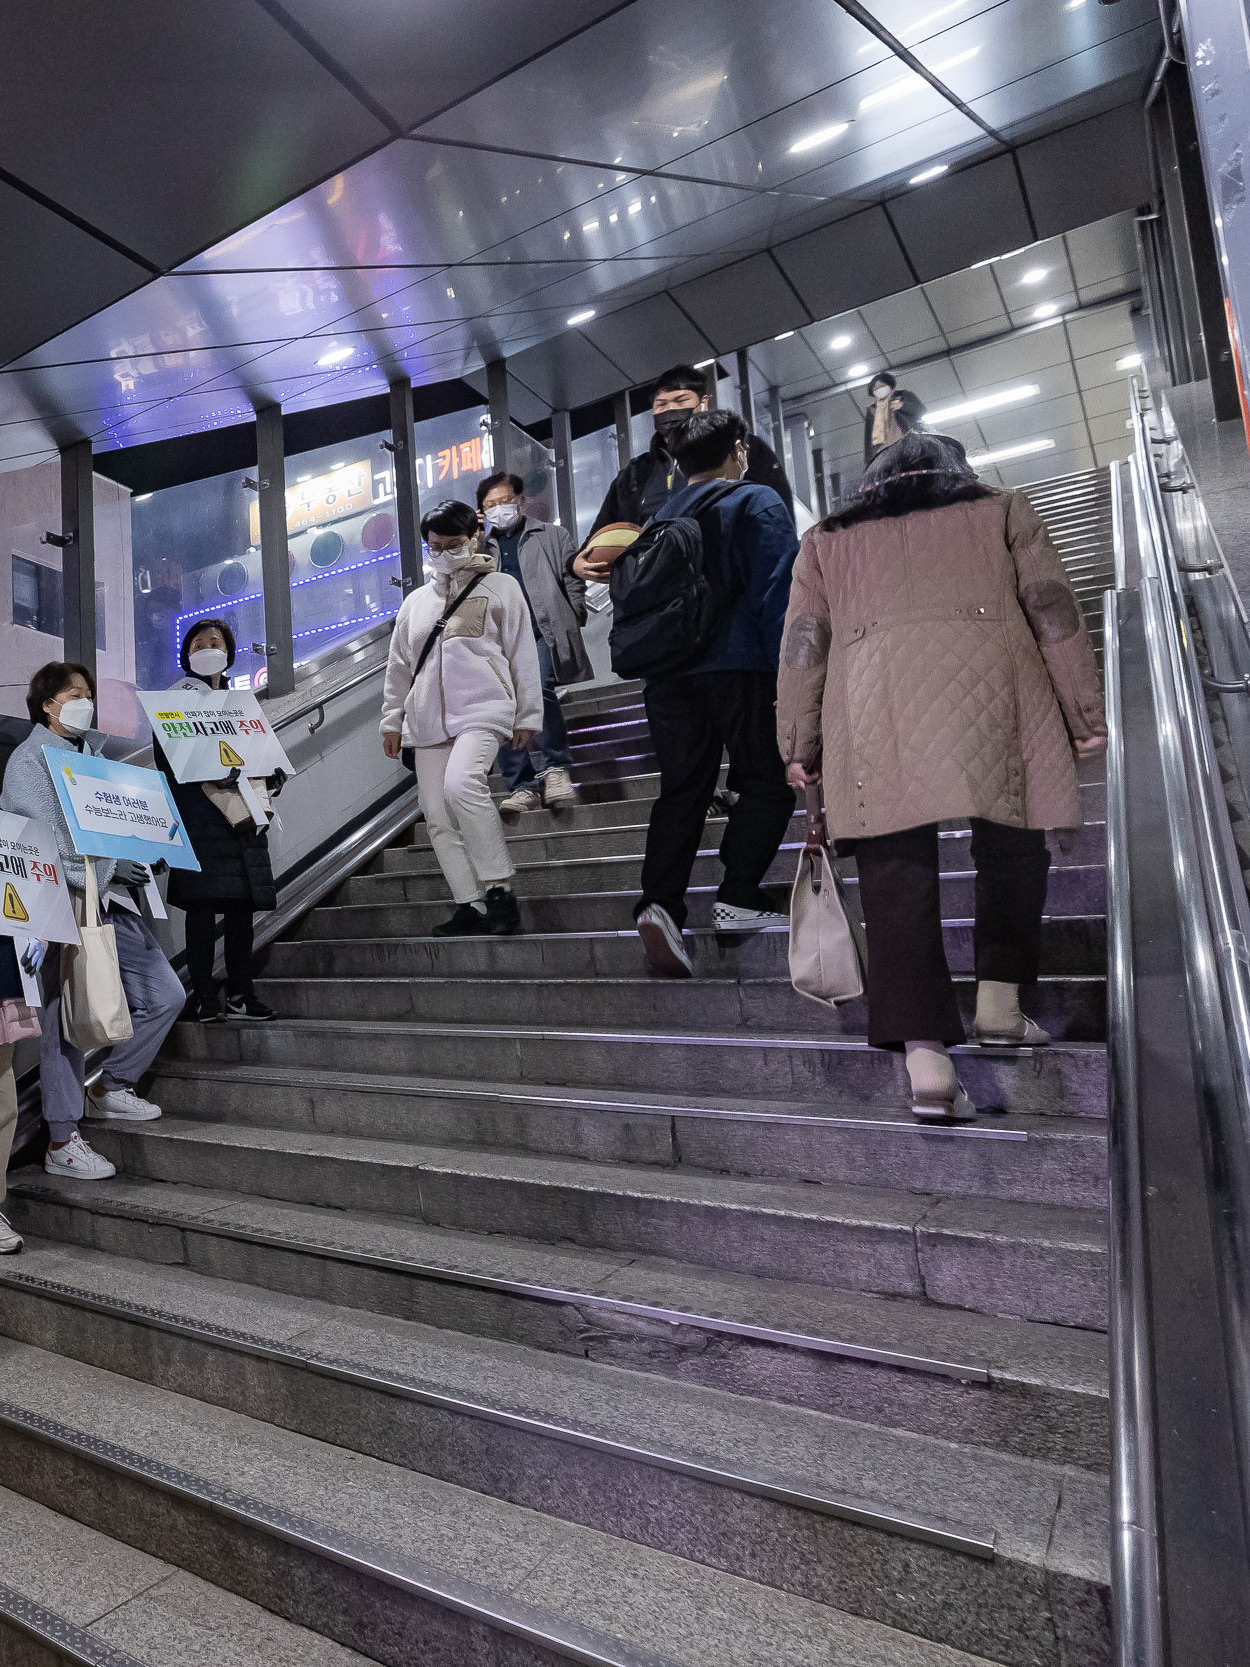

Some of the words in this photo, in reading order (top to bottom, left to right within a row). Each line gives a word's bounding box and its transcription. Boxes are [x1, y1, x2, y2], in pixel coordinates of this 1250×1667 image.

[184, 710, 203, 719] 인파가
[161, 719, 238, 739] 안전사고에
[236, 718, 267, 736] 주의
[94, 790, 122, 806] 수험생
[122, 795, 150, 812] 여러분
[84, 803, 128, 822] 수능보느라
[129, 810, 169, 829] 고생했어요
[29, 859, 59, 886] 주의
